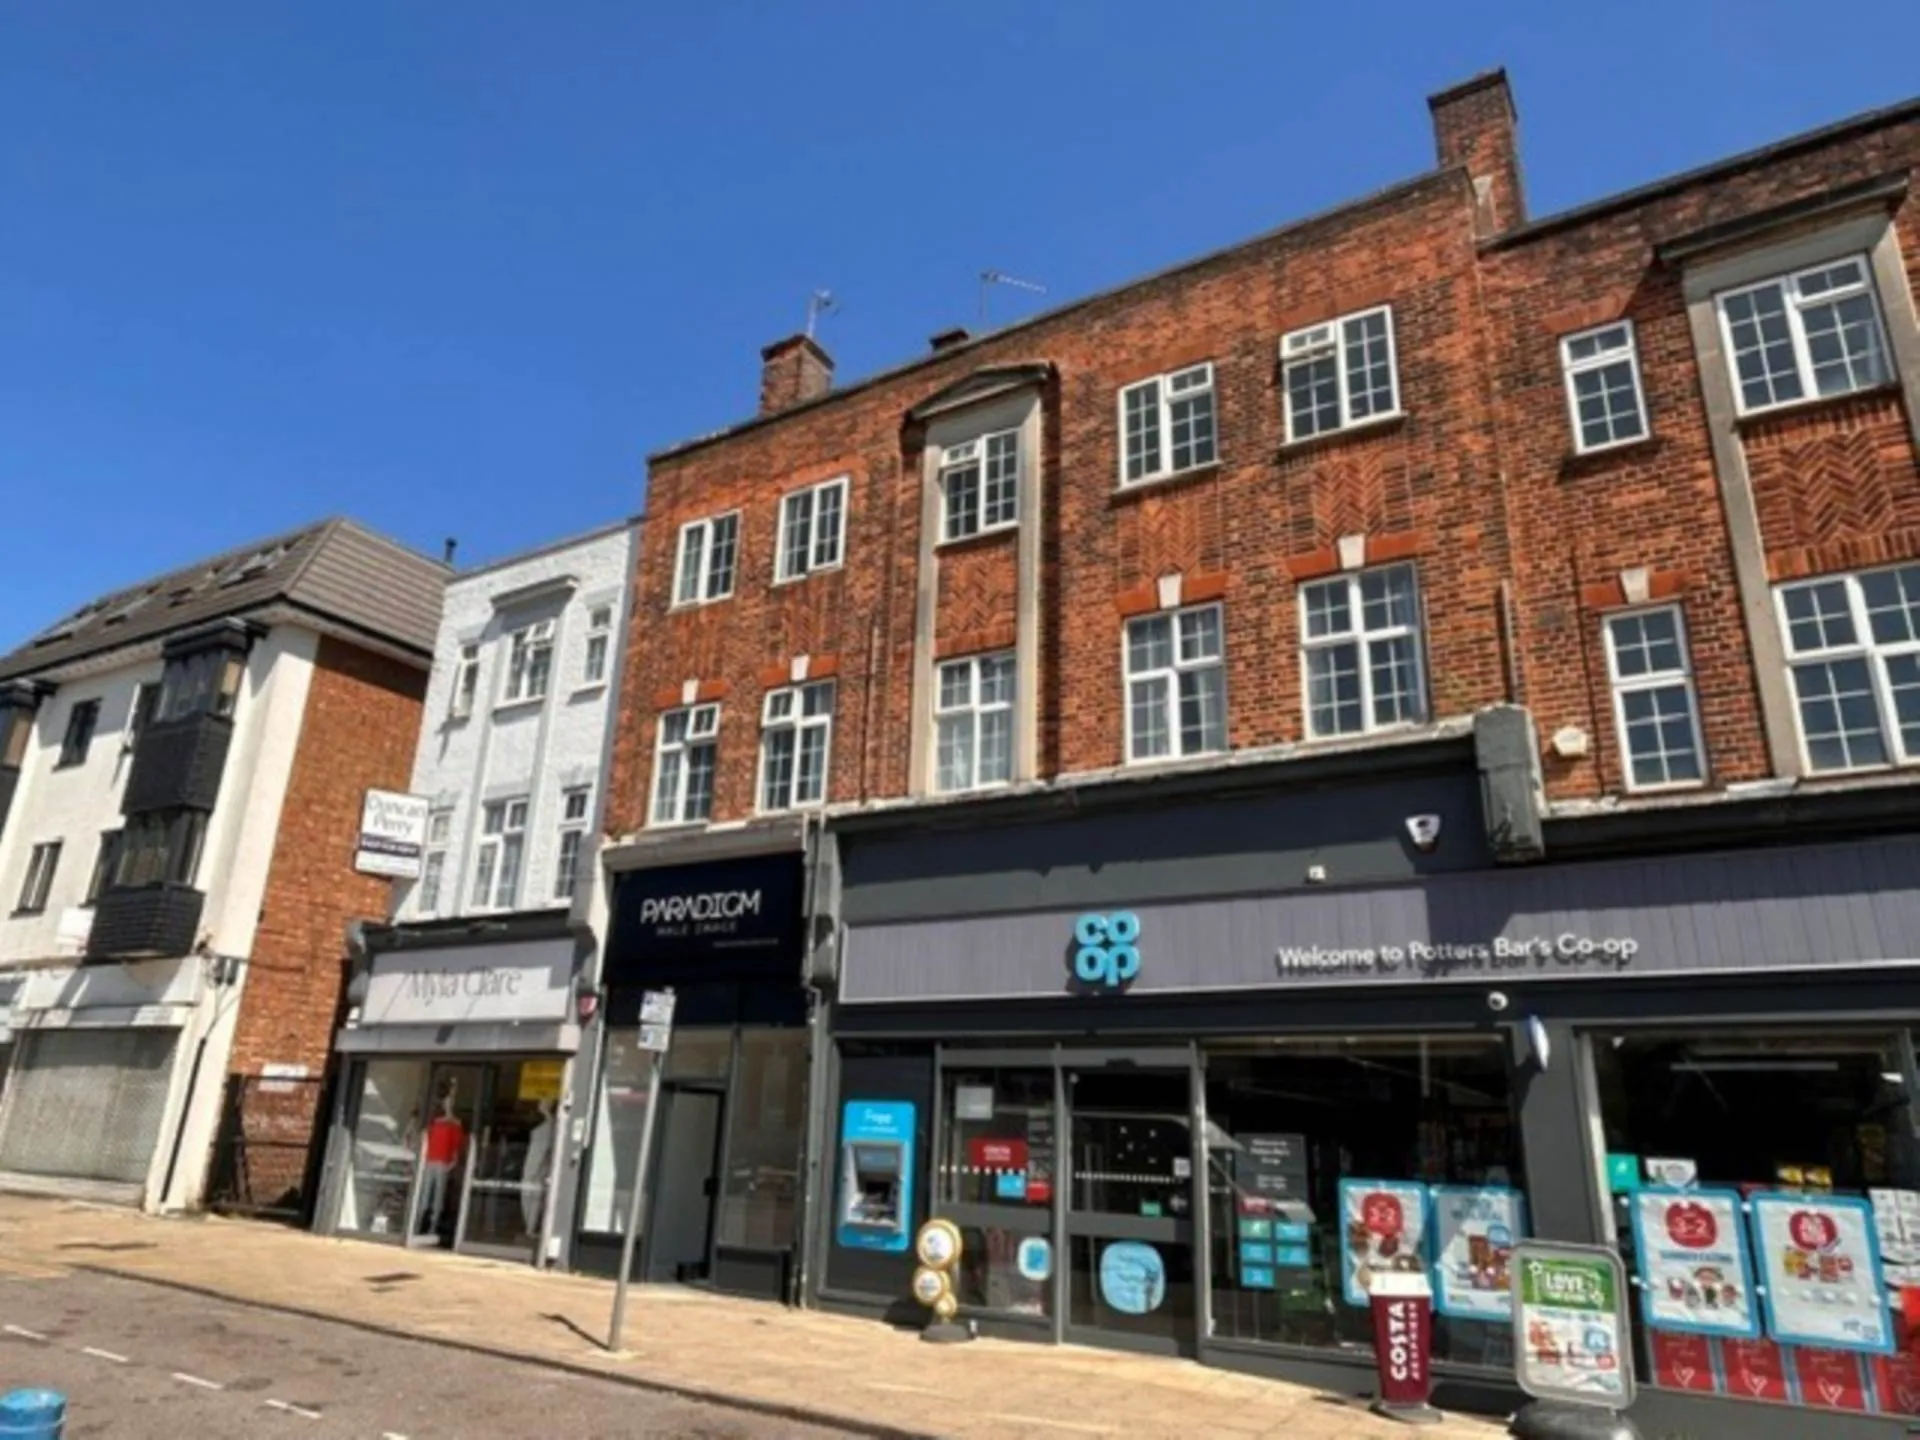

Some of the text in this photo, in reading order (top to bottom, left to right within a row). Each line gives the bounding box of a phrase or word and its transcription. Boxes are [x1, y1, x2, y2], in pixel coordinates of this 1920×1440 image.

[1278, 933, 1638, 968] Welcome to Potters Bar's Co-op
[464, 963, 522, 997] Clare
[1388, 1301, 1409, 1381] COSTA
